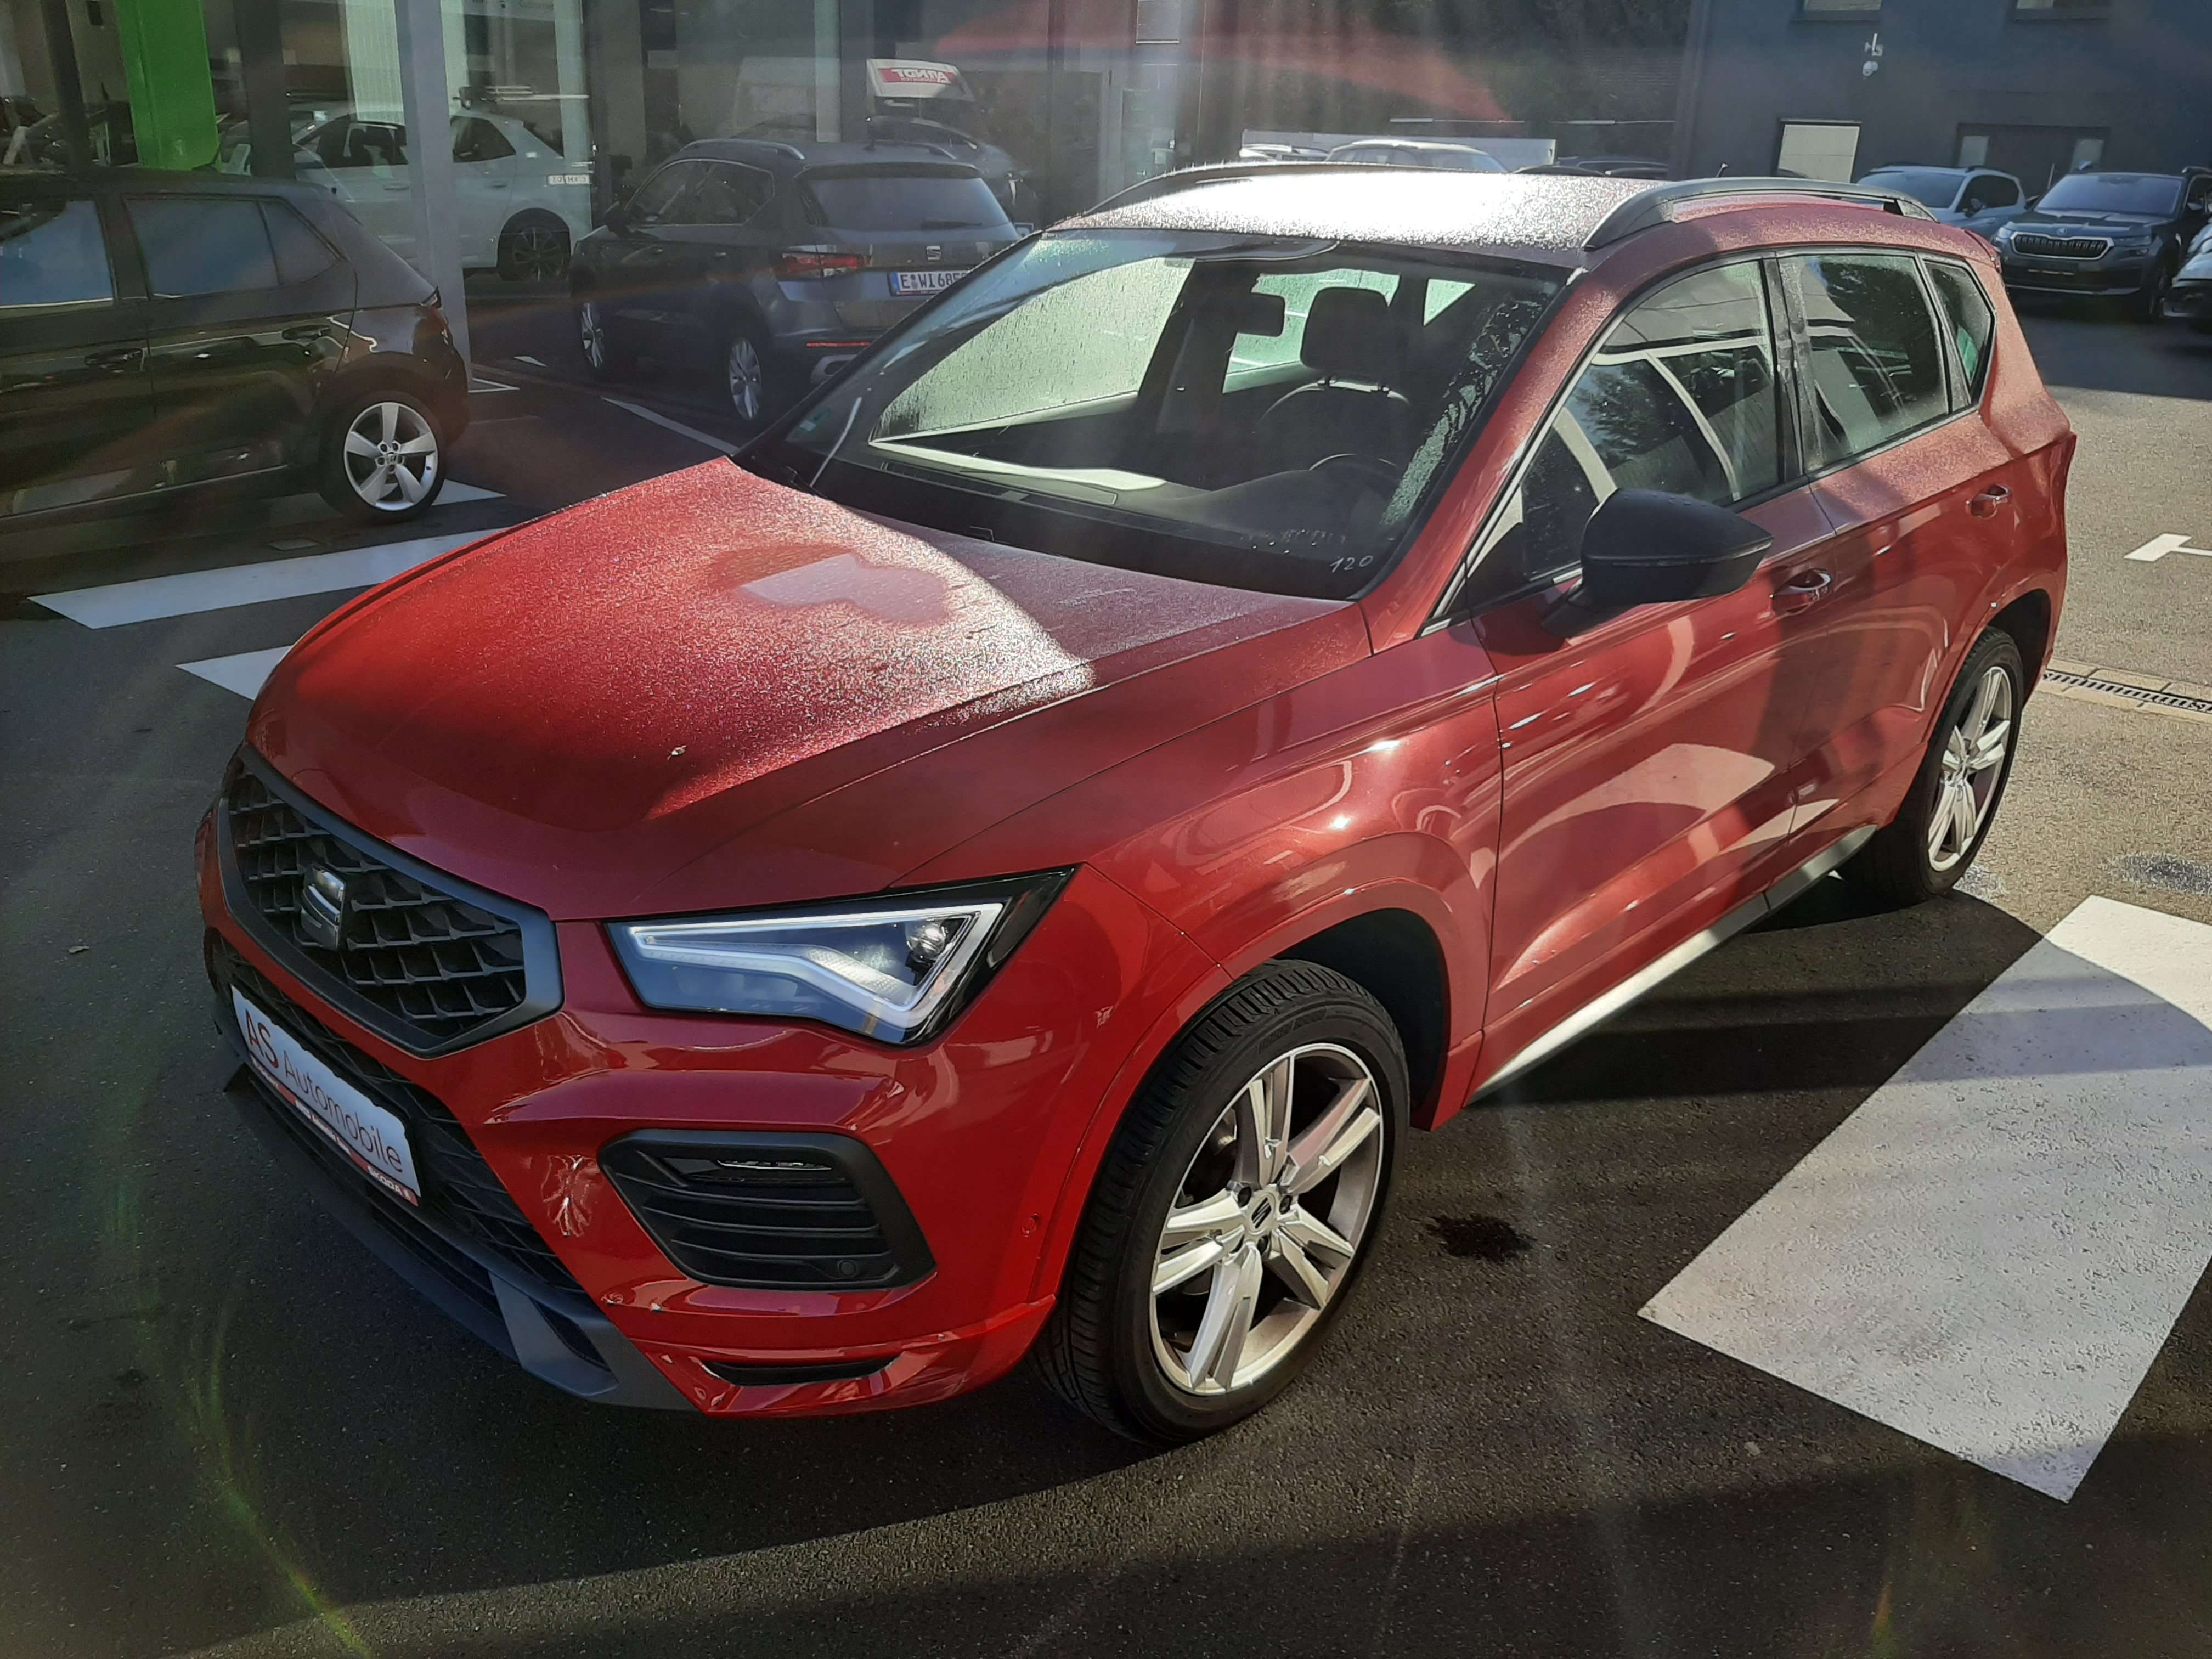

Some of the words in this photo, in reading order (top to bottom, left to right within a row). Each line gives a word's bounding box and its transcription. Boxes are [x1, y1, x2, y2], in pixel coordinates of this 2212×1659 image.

[900, 274, 910, 289] E
[919, 274, 935, 289] WI
[1330, 555, 1373, 573] 120
[246, 1008, 279, 1069] AS
[283, 1049, 403, 1172] Automobile
